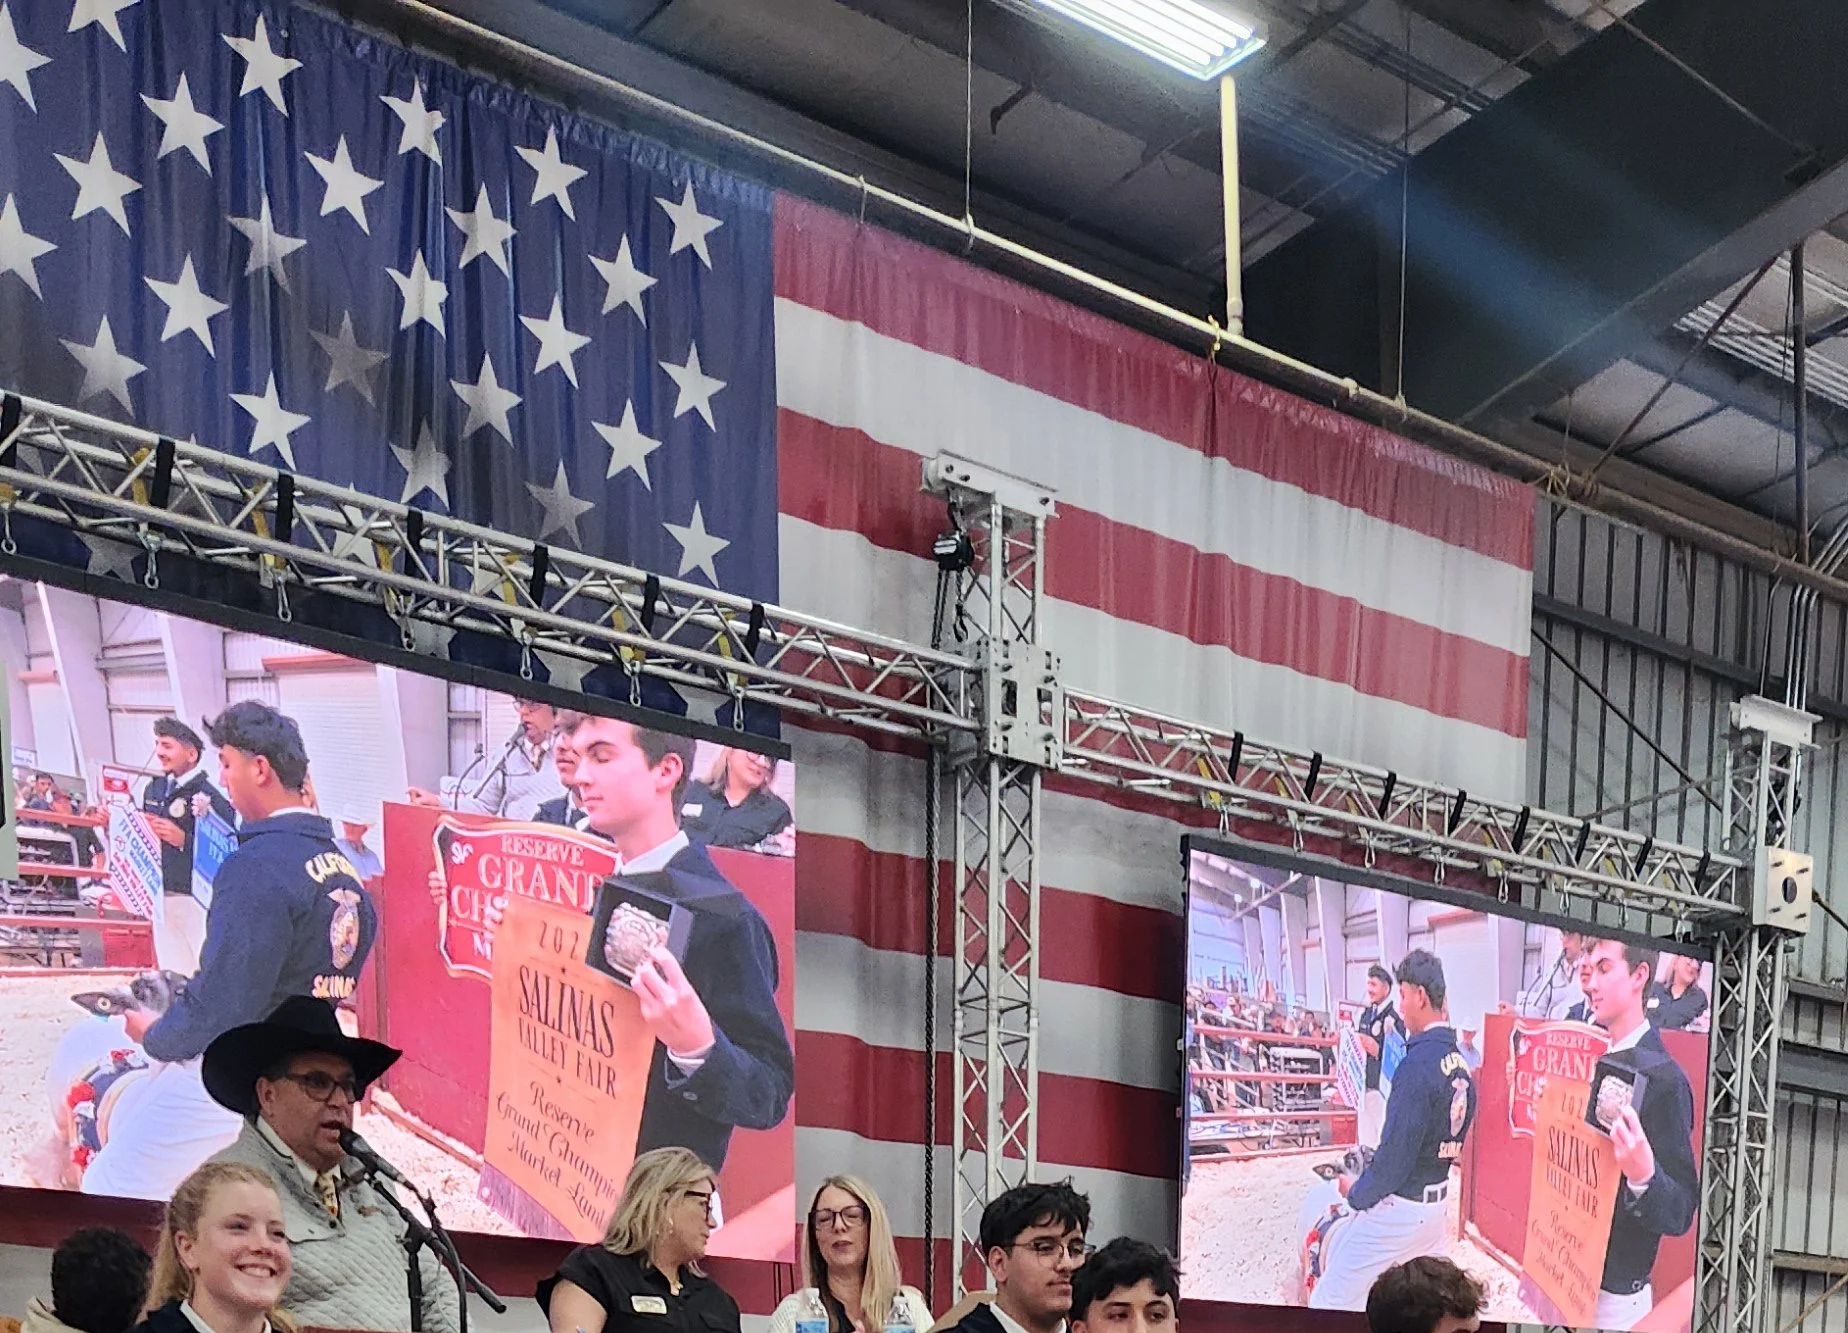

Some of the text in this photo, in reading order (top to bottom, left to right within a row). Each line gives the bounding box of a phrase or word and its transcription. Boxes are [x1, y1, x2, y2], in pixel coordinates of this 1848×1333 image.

[501, 834, 585, 867] RESERVE
[539, 919, 580, 960] 202
[519, 965, 615, 1058] SALINAS
[518, 1017, 617, 1099] VALLEY FAIR
[496, 1091, 541, 1141] Grand
[530, 1080, 595, 1144] Reserve
[1561, 1091, 1585, 1120] 202
[507, 1130, 562, 1189] Market
[1548, 1125, 1600, 1190] SALINAS
